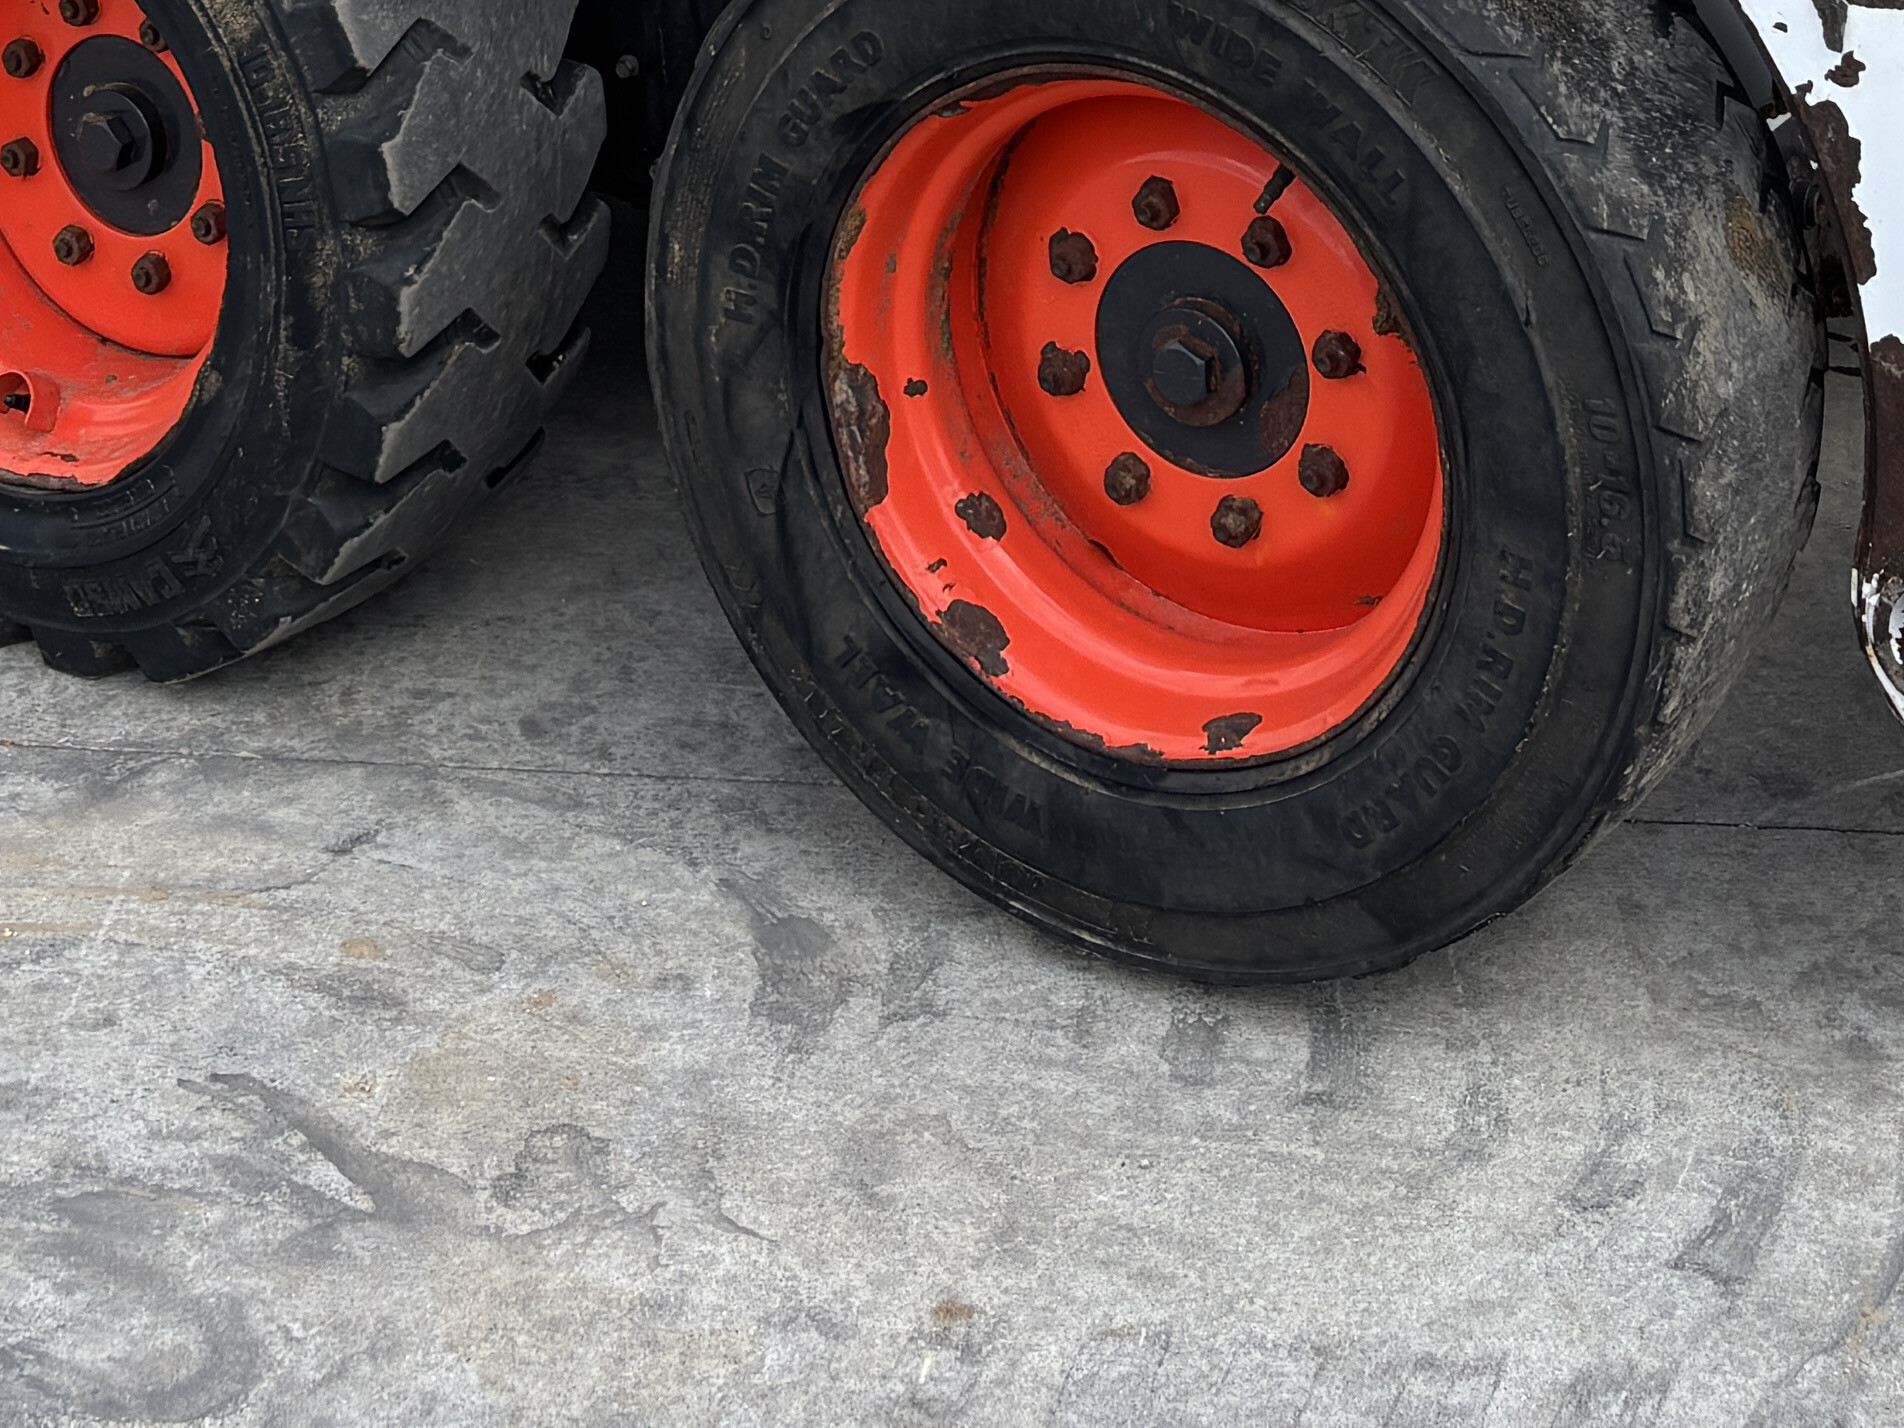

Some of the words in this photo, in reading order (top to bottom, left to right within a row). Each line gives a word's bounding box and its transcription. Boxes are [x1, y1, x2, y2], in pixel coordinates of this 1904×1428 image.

[778, 30, 885, 146] GUARD
[1168, 0, 1283, 88] WIDE
[1298, 77, 1406, 208] WALL
[1342, 735, 1463, 849] GUARD
